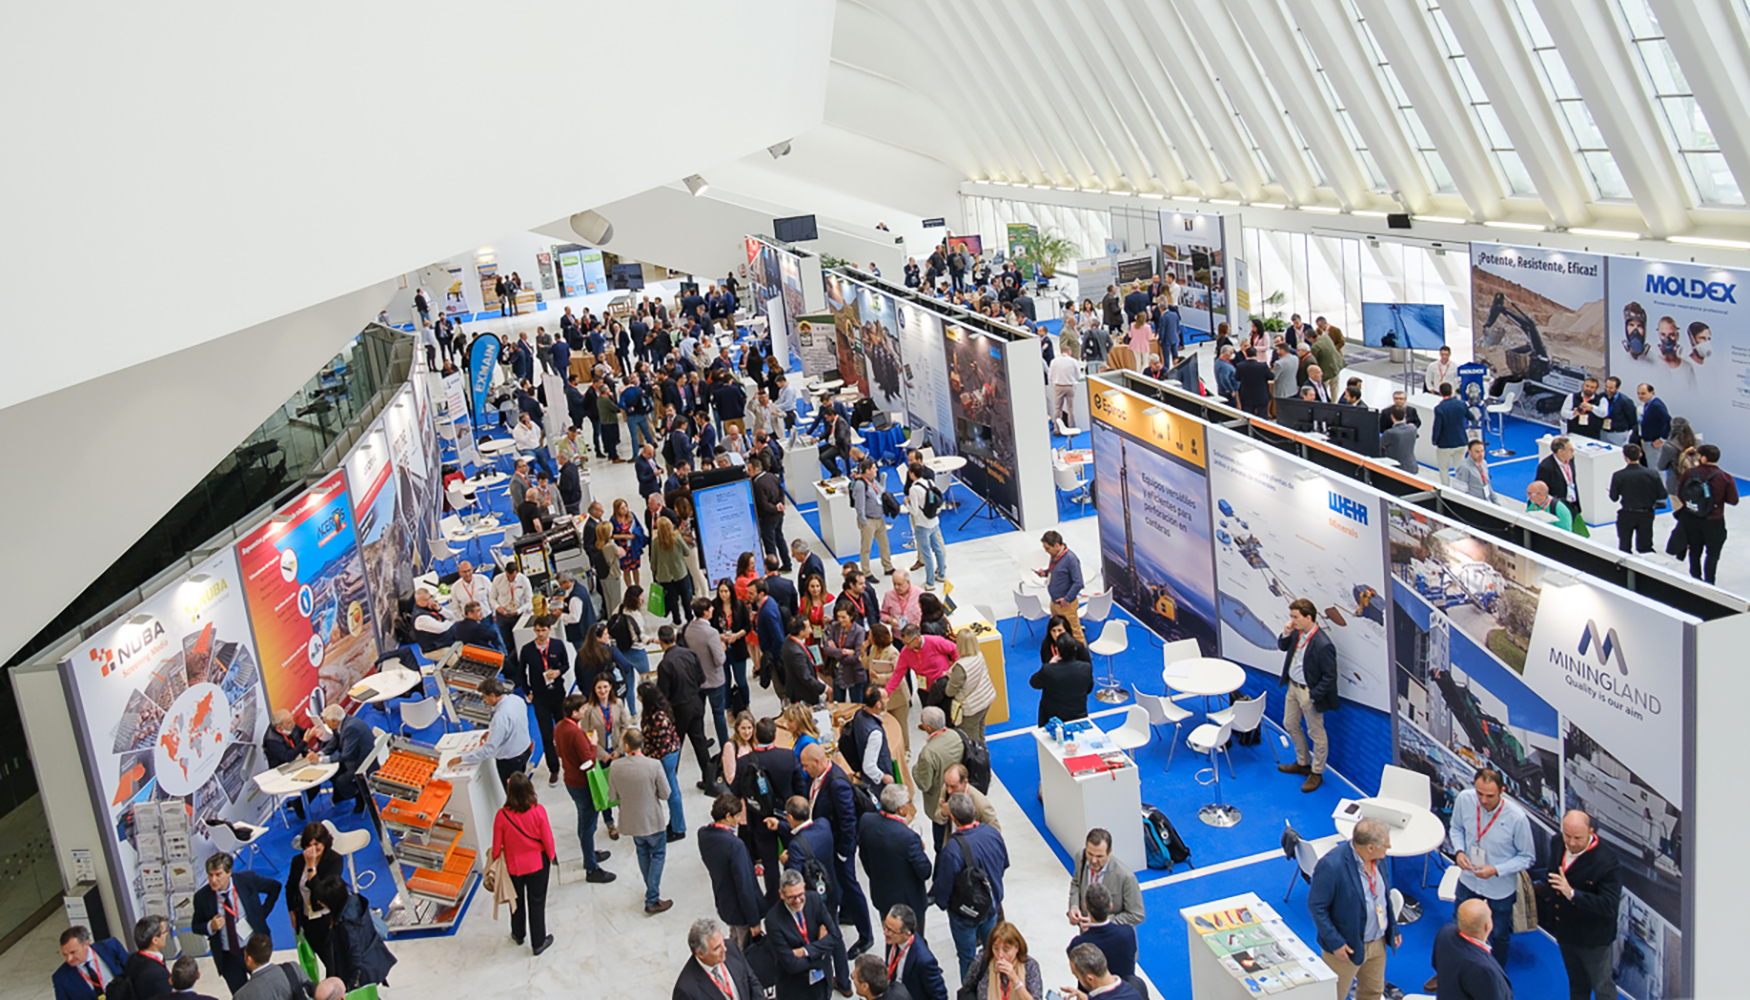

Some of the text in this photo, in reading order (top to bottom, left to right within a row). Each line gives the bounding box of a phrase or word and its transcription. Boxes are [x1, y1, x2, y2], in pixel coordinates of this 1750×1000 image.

[1477, 252, 1598, 277] ¡Potente, Resistente, Eficaz!
[1645, 273, 1737, 304] MOLDEX
[475, 344, 497, 393] EXMAIN
[1102, 398, 1127, 421] Epiroc
[1141, 472, 1197, 510] Equipos versátiles
[1148, 491, 1177, 513] eficientes
[1177, 507, 1193, 522] para
[1328, 490, 1369, 526] WEIR
[1144, 515, 1171, 538] canteras
[1178, 522, 1188, 533] en
[1328, 517, 1359, 539] Minerals
[199, 577, 229, 608] NUBA
[117, 620, 166, 665] NUBA
[1549, 647, 1662, 715] MININGLAND
[1564, 674, 1644, 721] Quality is our aim
